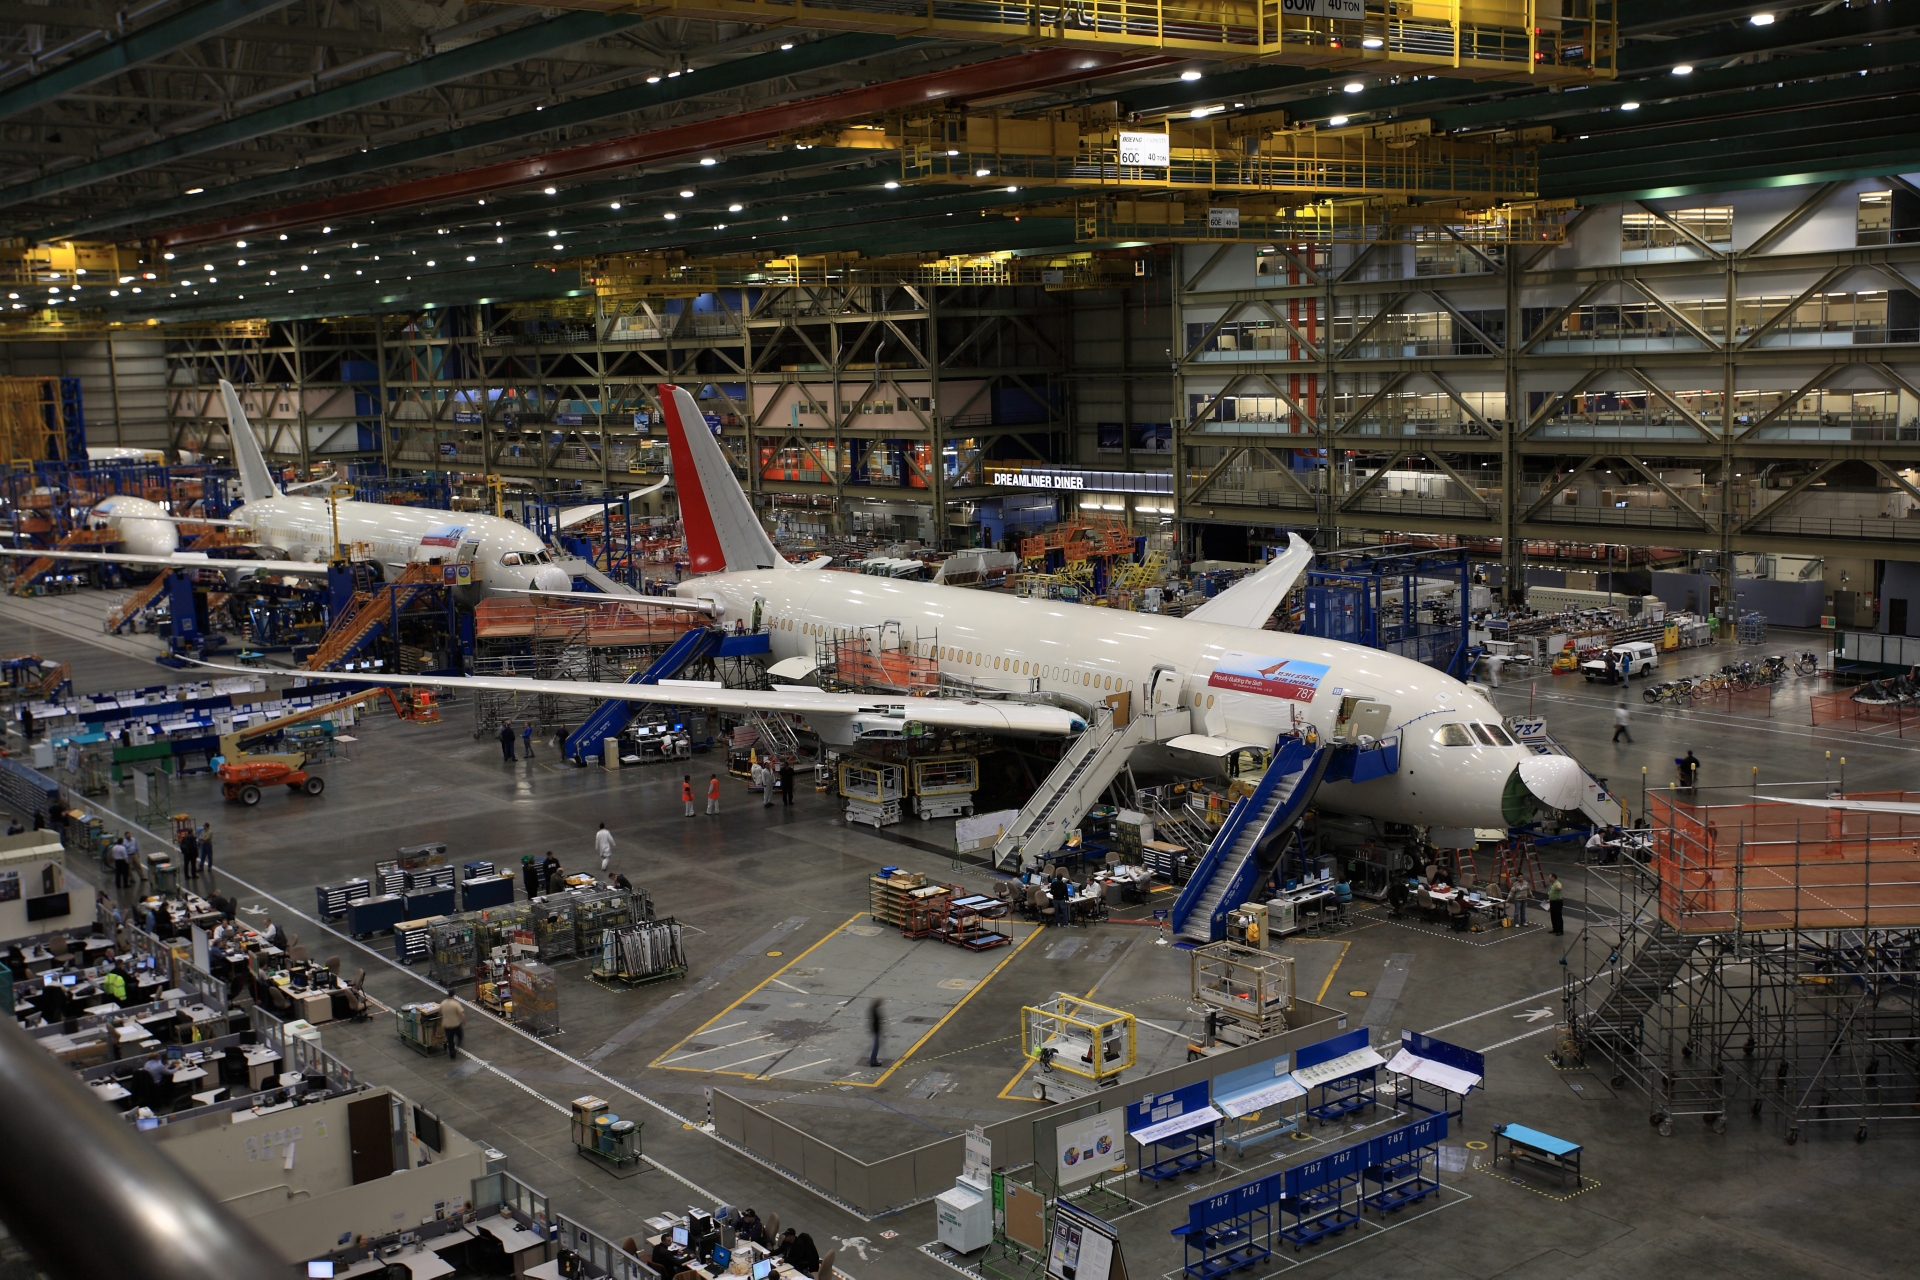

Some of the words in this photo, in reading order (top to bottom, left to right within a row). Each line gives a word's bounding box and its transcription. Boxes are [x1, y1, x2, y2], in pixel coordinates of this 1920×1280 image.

[1328, 0, 1342, 11] 40
[1343, 1, 1360, 12] TON
[1122, 152, 1140, 163] 60C
[1148, 153, 1156, 161] 40
[994, 473, 1052, 488] DREAMLINER
[1053, 475, 1084, 489] DINER
[1214, 674, 1228, 682] Proudly
[1228, 677, 1245, 685] Building
[1289, 679, 1315, 687] INDIA
[1296, 687, 1315, 700] 787
[1514, 722, 1544, 736] 787
[1414, 1122, 1431, 1135] 787
[966, 1131, 978, 1141] SAFETY
[1387, 1132, 1404, 1145] 787
[1333, 1152, 1351, 1164] 787
[1303, 1162, 1322, 1175] 787
[1242, 1184, 1261, 1197] 787
[1209, 1195, 1230, 1209] 787
